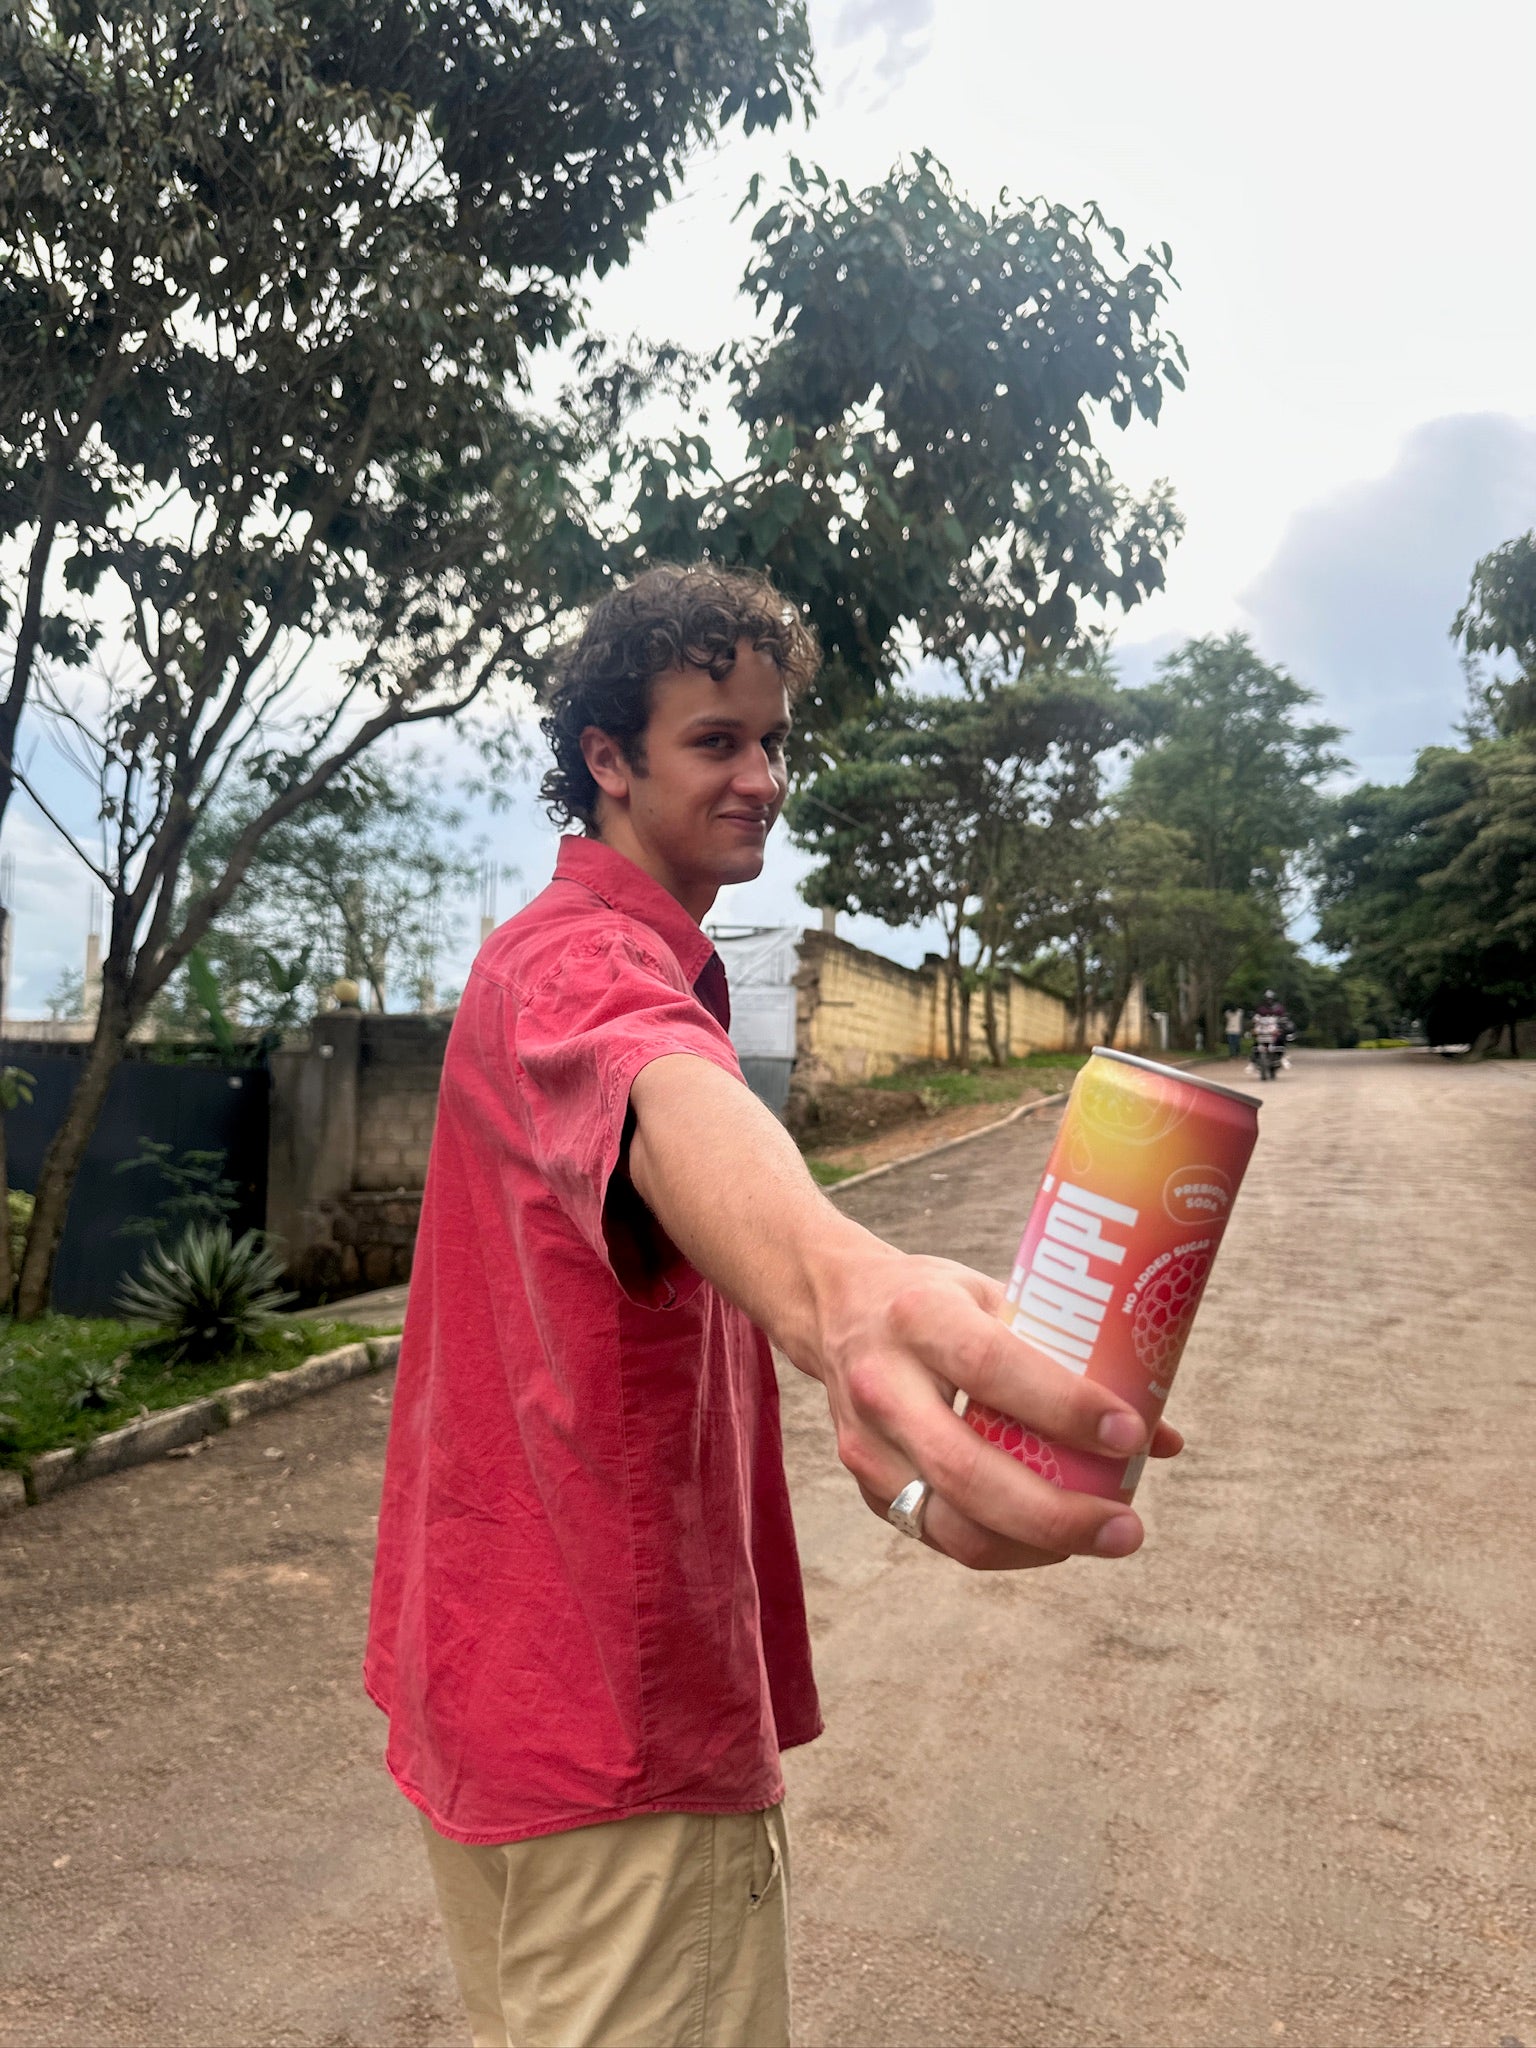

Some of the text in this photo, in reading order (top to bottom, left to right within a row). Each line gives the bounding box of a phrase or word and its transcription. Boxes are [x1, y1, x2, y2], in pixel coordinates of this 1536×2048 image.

[1186, 1197, 1218, 1212] SODA
[1122, 1239, 1210, 1315] NO ADDED SUGAR
